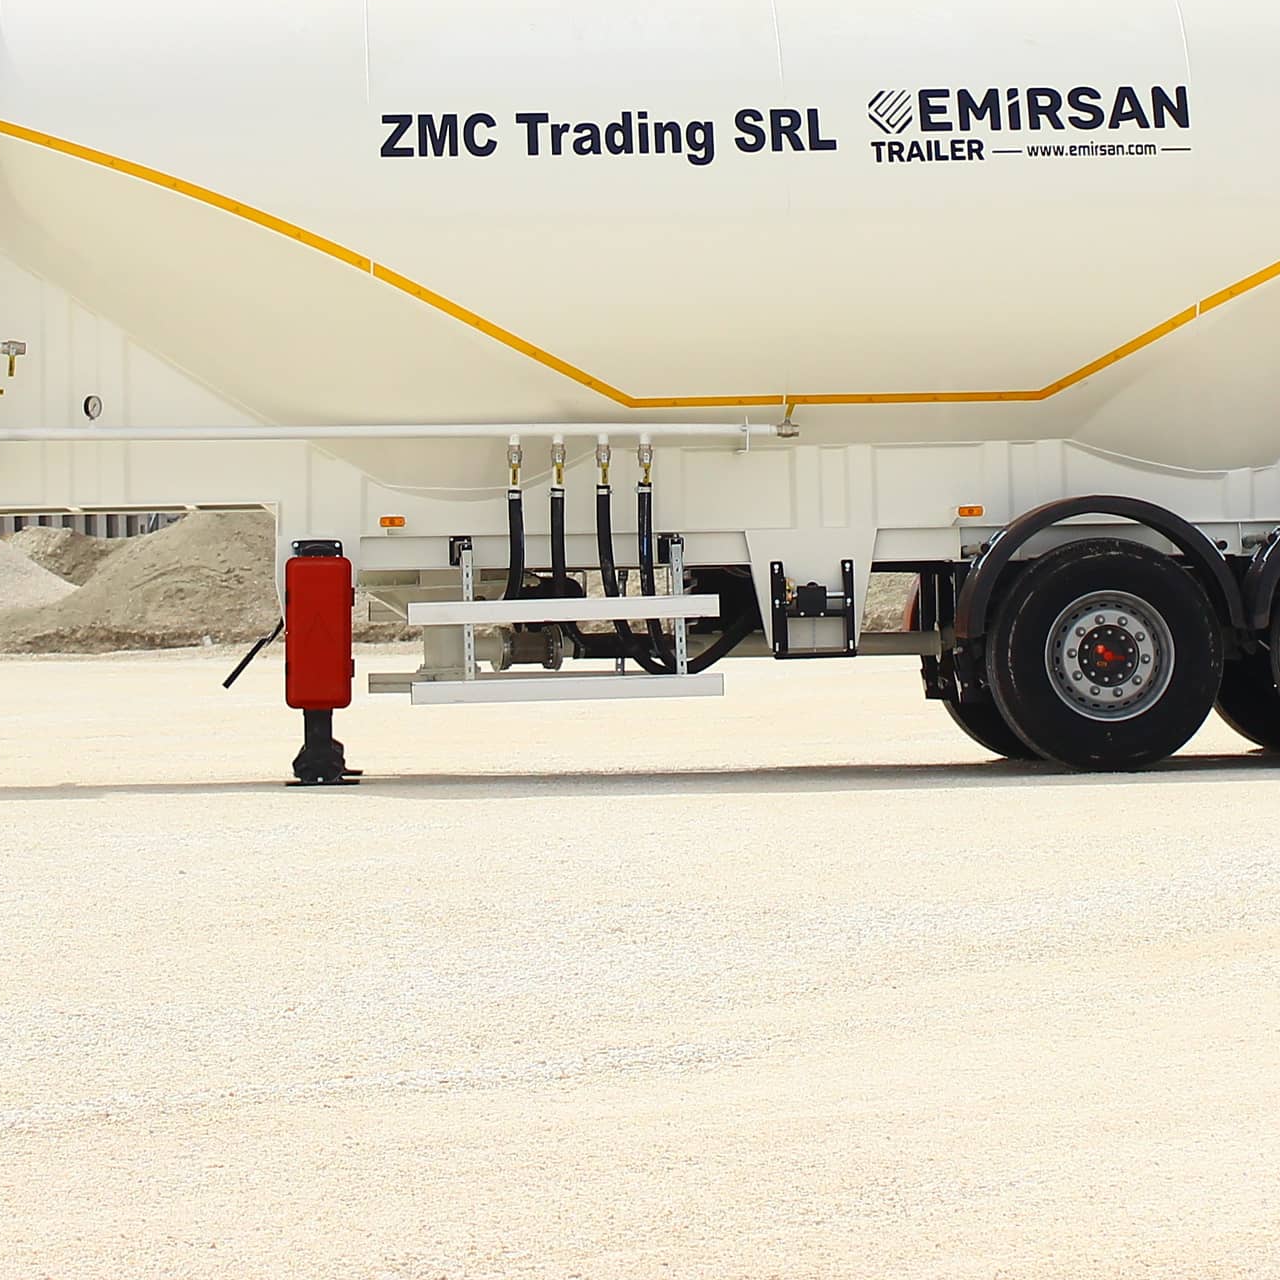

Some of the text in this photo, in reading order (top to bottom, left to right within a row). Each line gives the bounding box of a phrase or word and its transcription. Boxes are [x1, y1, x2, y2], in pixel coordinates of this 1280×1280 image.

[380, 108, 837, 166] ZMC Trading SRL
[870, 139, 1157, 162] TRAILER www.emirsan.com
